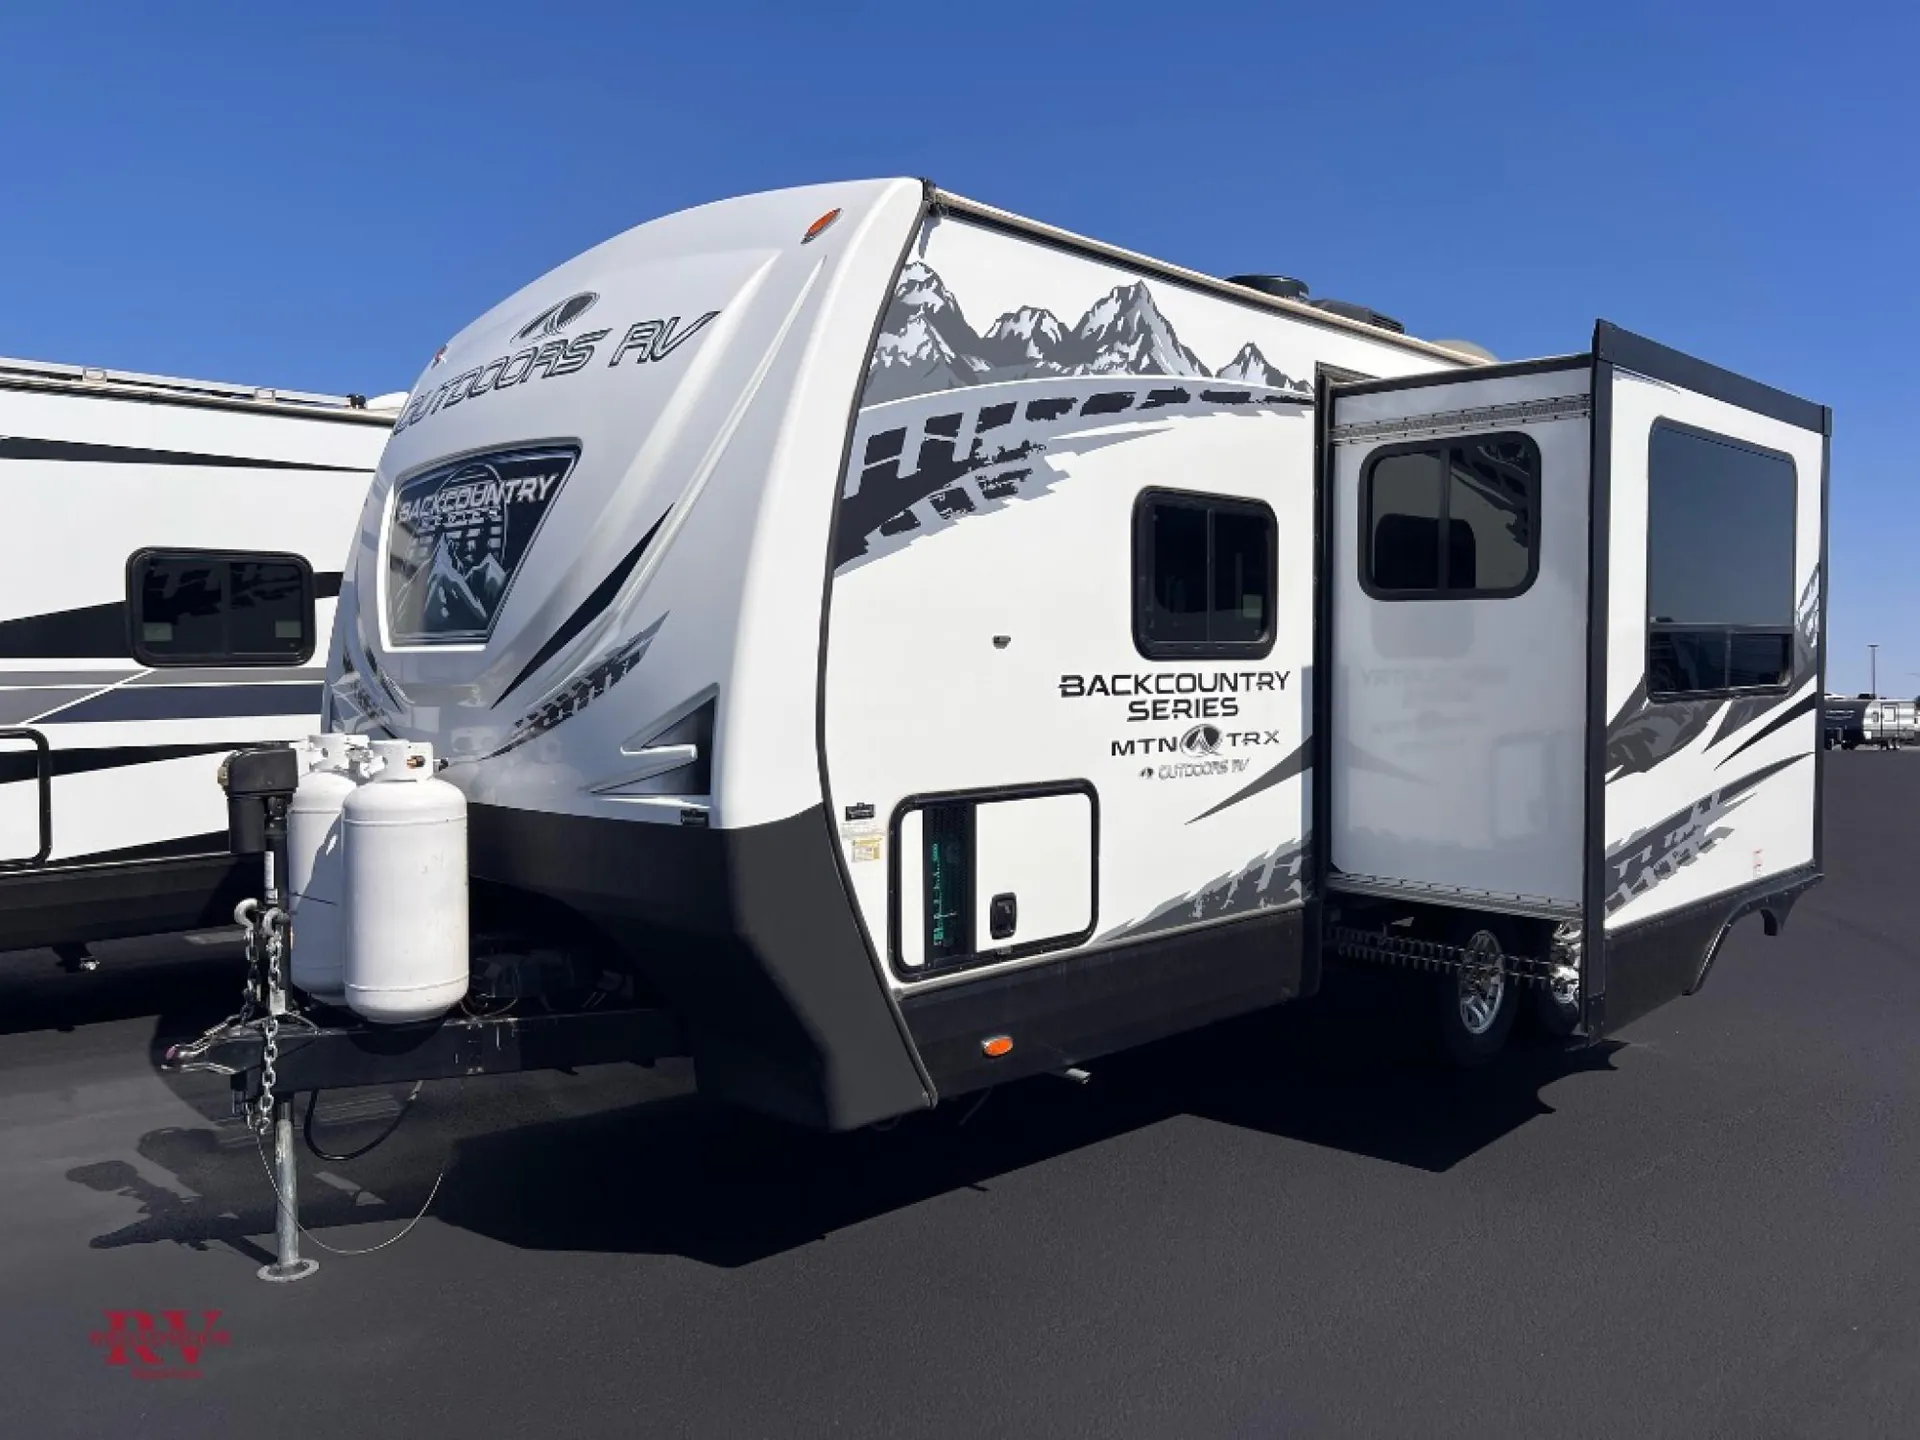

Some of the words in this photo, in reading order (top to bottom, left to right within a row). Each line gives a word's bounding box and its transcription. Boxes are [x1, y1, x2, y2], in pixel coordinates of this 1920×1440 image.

[607, 310, 722, 368] RV
[399, 473, 560, 523] BACKCOUNTRY
[1058, 671, 1291, 698] BACKCOUNTRY
[1127, 697, 1240, 722] SERIES
[1111, 737, 1178, 756] MTN
[1226, 729, 1282, 747] TRX
[1158, 759, 1229, 780] OUTDOORS
[1231, 757, 1250, 774] RV
